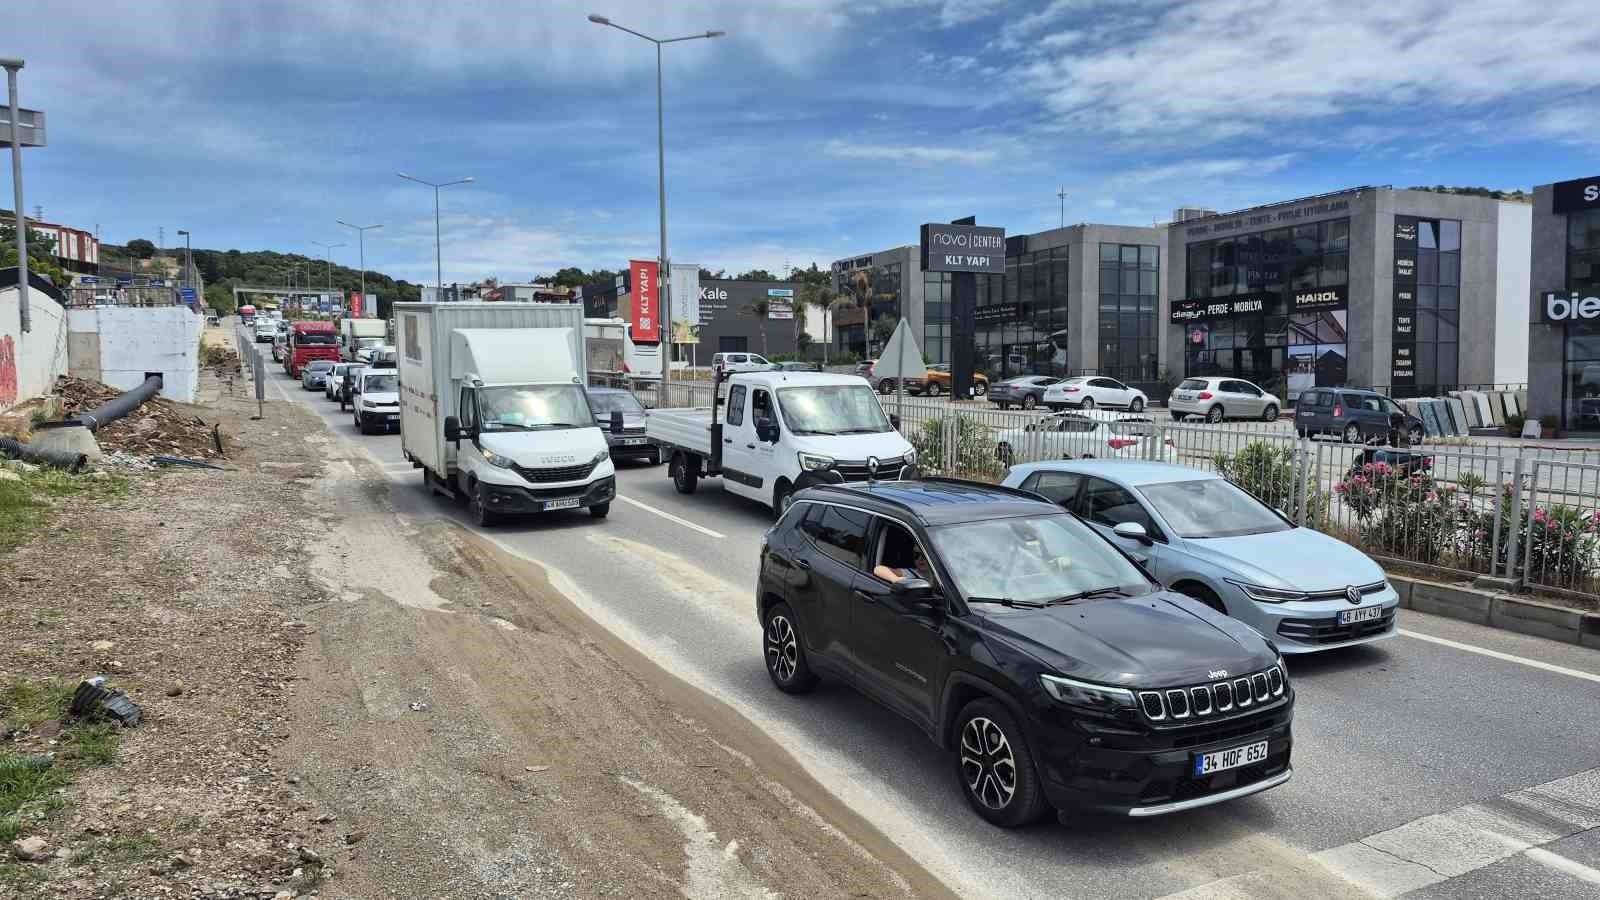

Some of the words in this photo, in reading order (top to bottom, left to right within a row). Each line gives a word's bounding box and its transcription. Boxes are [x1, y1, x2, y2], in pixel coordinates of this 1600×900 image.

[1583, 185, 1600, 201] S
[973, 235, 1001, 248] CENTER
[945, 255, 963, 265] KLT
[966, 255, 990, 266] YAPI
[640, 268, 649, 293] YAPI
[699, 287, 728, 300] Kale
[1296, 291, 1339, 303] HAROL
[640, 295, 649, 314] KLT
[1207, 304, 1230, 315] PERDE
[1233, 299, 1263, 312] MOBİLYA
[1208, 669, 1228, 679] Jeep
[1203, 754, 1218, 772] 34
[1222, 748, 1243, 768] HDF
[1246, 743, 1267, 762] 652
